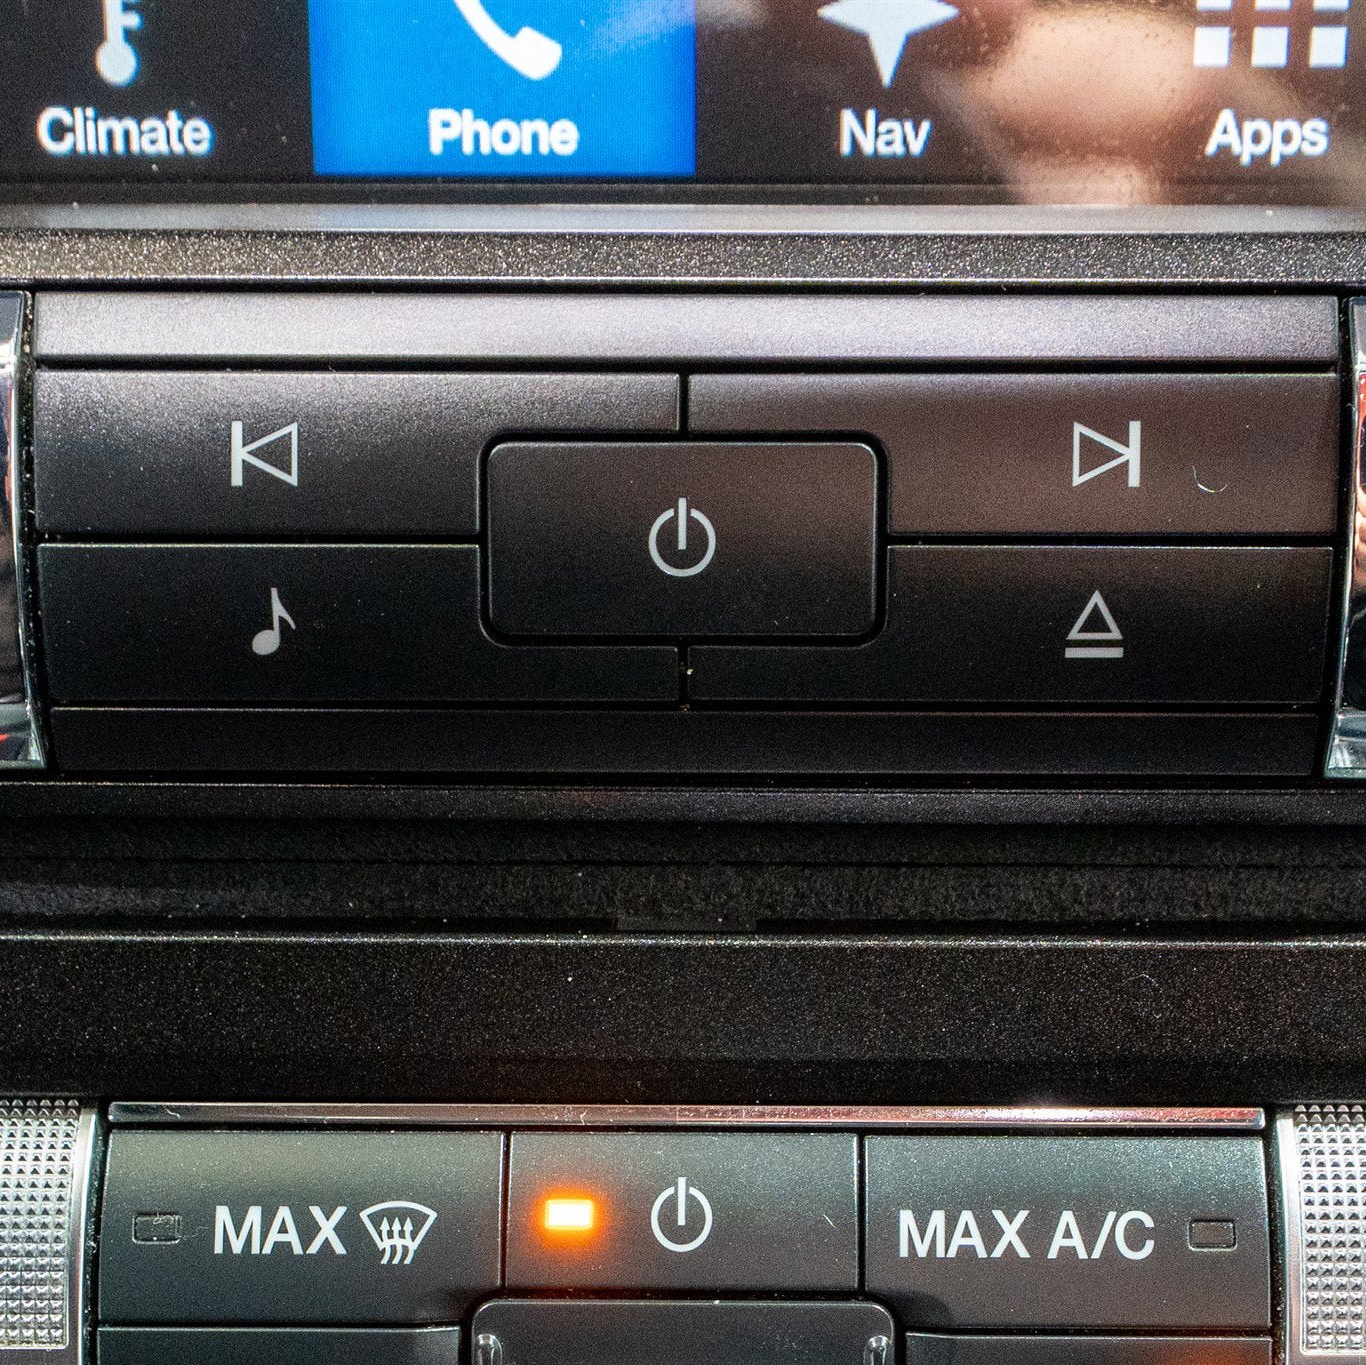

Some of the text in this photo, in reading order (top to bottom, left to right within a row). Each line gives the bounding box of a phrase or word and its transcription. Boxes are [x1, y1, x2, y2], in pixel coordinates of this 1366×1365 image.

[36, 105, 212, 157] Climate
[429, 108, 579, 157] Phone
[839, 108, 932, 157] Nav
[1204, 109, 1329, 166] Apps
[213, 1204, 348, 1256] MAX
[897, 1208, 1156, 1260] MAX A/C
